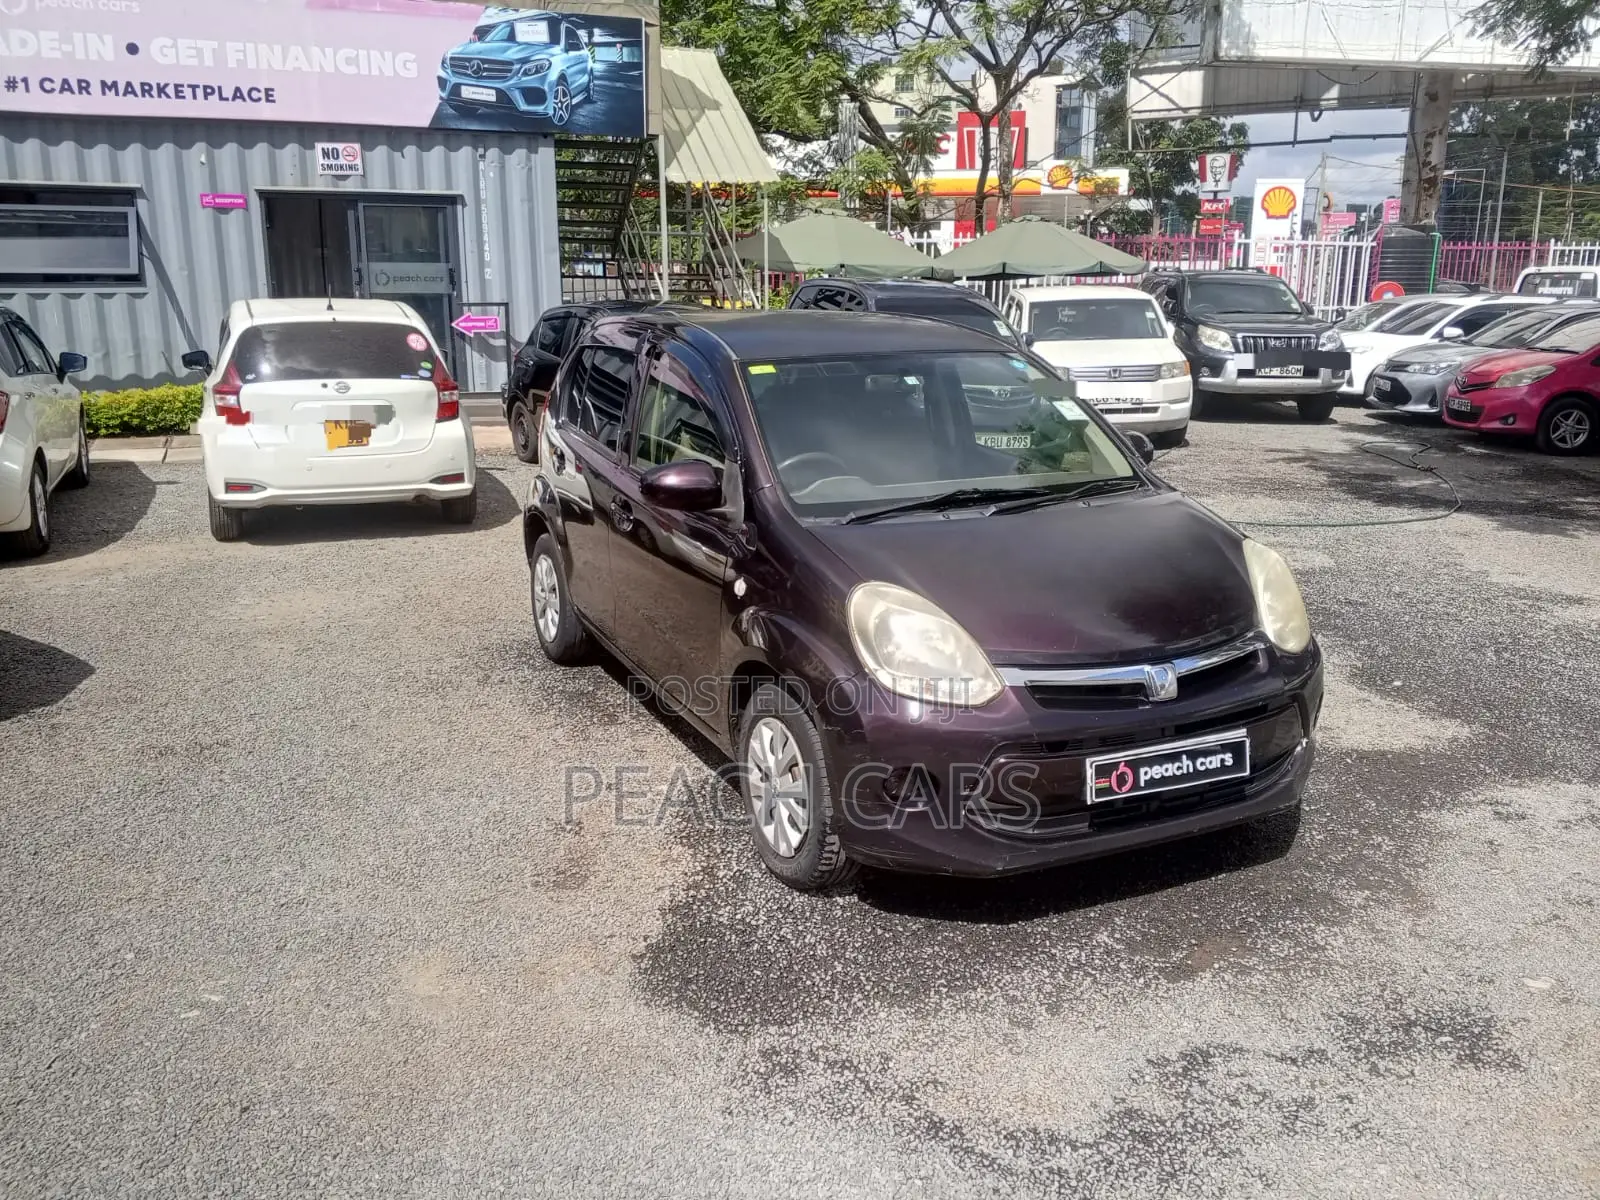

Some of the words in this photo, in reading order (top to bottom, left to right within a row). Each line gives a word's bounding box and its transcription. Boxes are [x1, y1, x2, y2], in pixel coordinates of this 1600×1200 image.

[98, 0, 142, 13] cars
[150, 36, 218, 67] GET
[226, 41, 419, 78] FINANCING
[4, 75, 31, 94] #1
[38, 77, 92, 96] CAR
[100, 79, 277, 104] MARKETPLACE
[321, 147, 340, 160] NO
[320, 162, 360, 173] SMOKING
[393, 273, 422, 285] peach
[424, 275, 444, 283] cars
[1006, 436, 1029, 448] 879S
[1139, 754, 1194, 787] peach
[1196, 751, 1234, 772] cars
